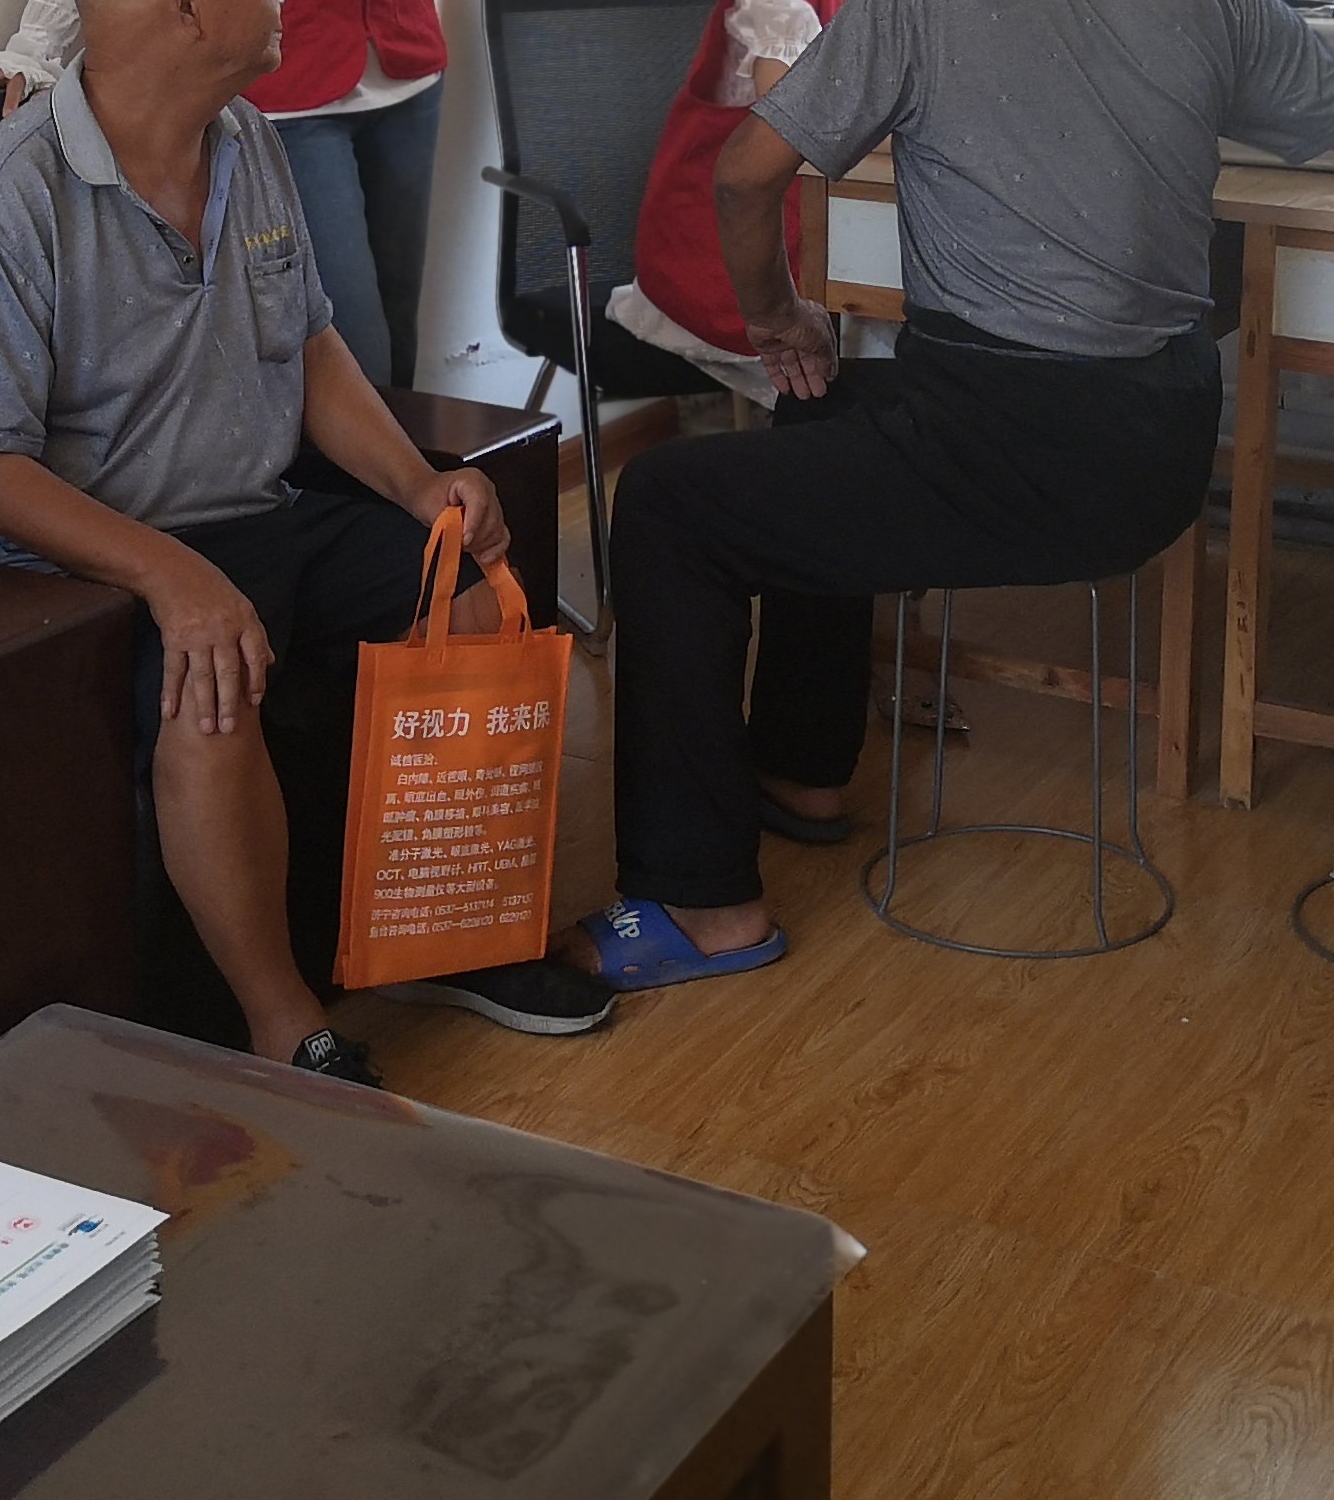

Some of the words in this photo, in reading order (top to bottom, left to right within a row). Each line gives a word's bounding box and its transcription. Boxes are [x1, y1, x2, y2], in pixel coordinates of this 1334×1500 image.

[391, 707, 470, 740] 好视力
[486, 701, 550, 736] 我来保
